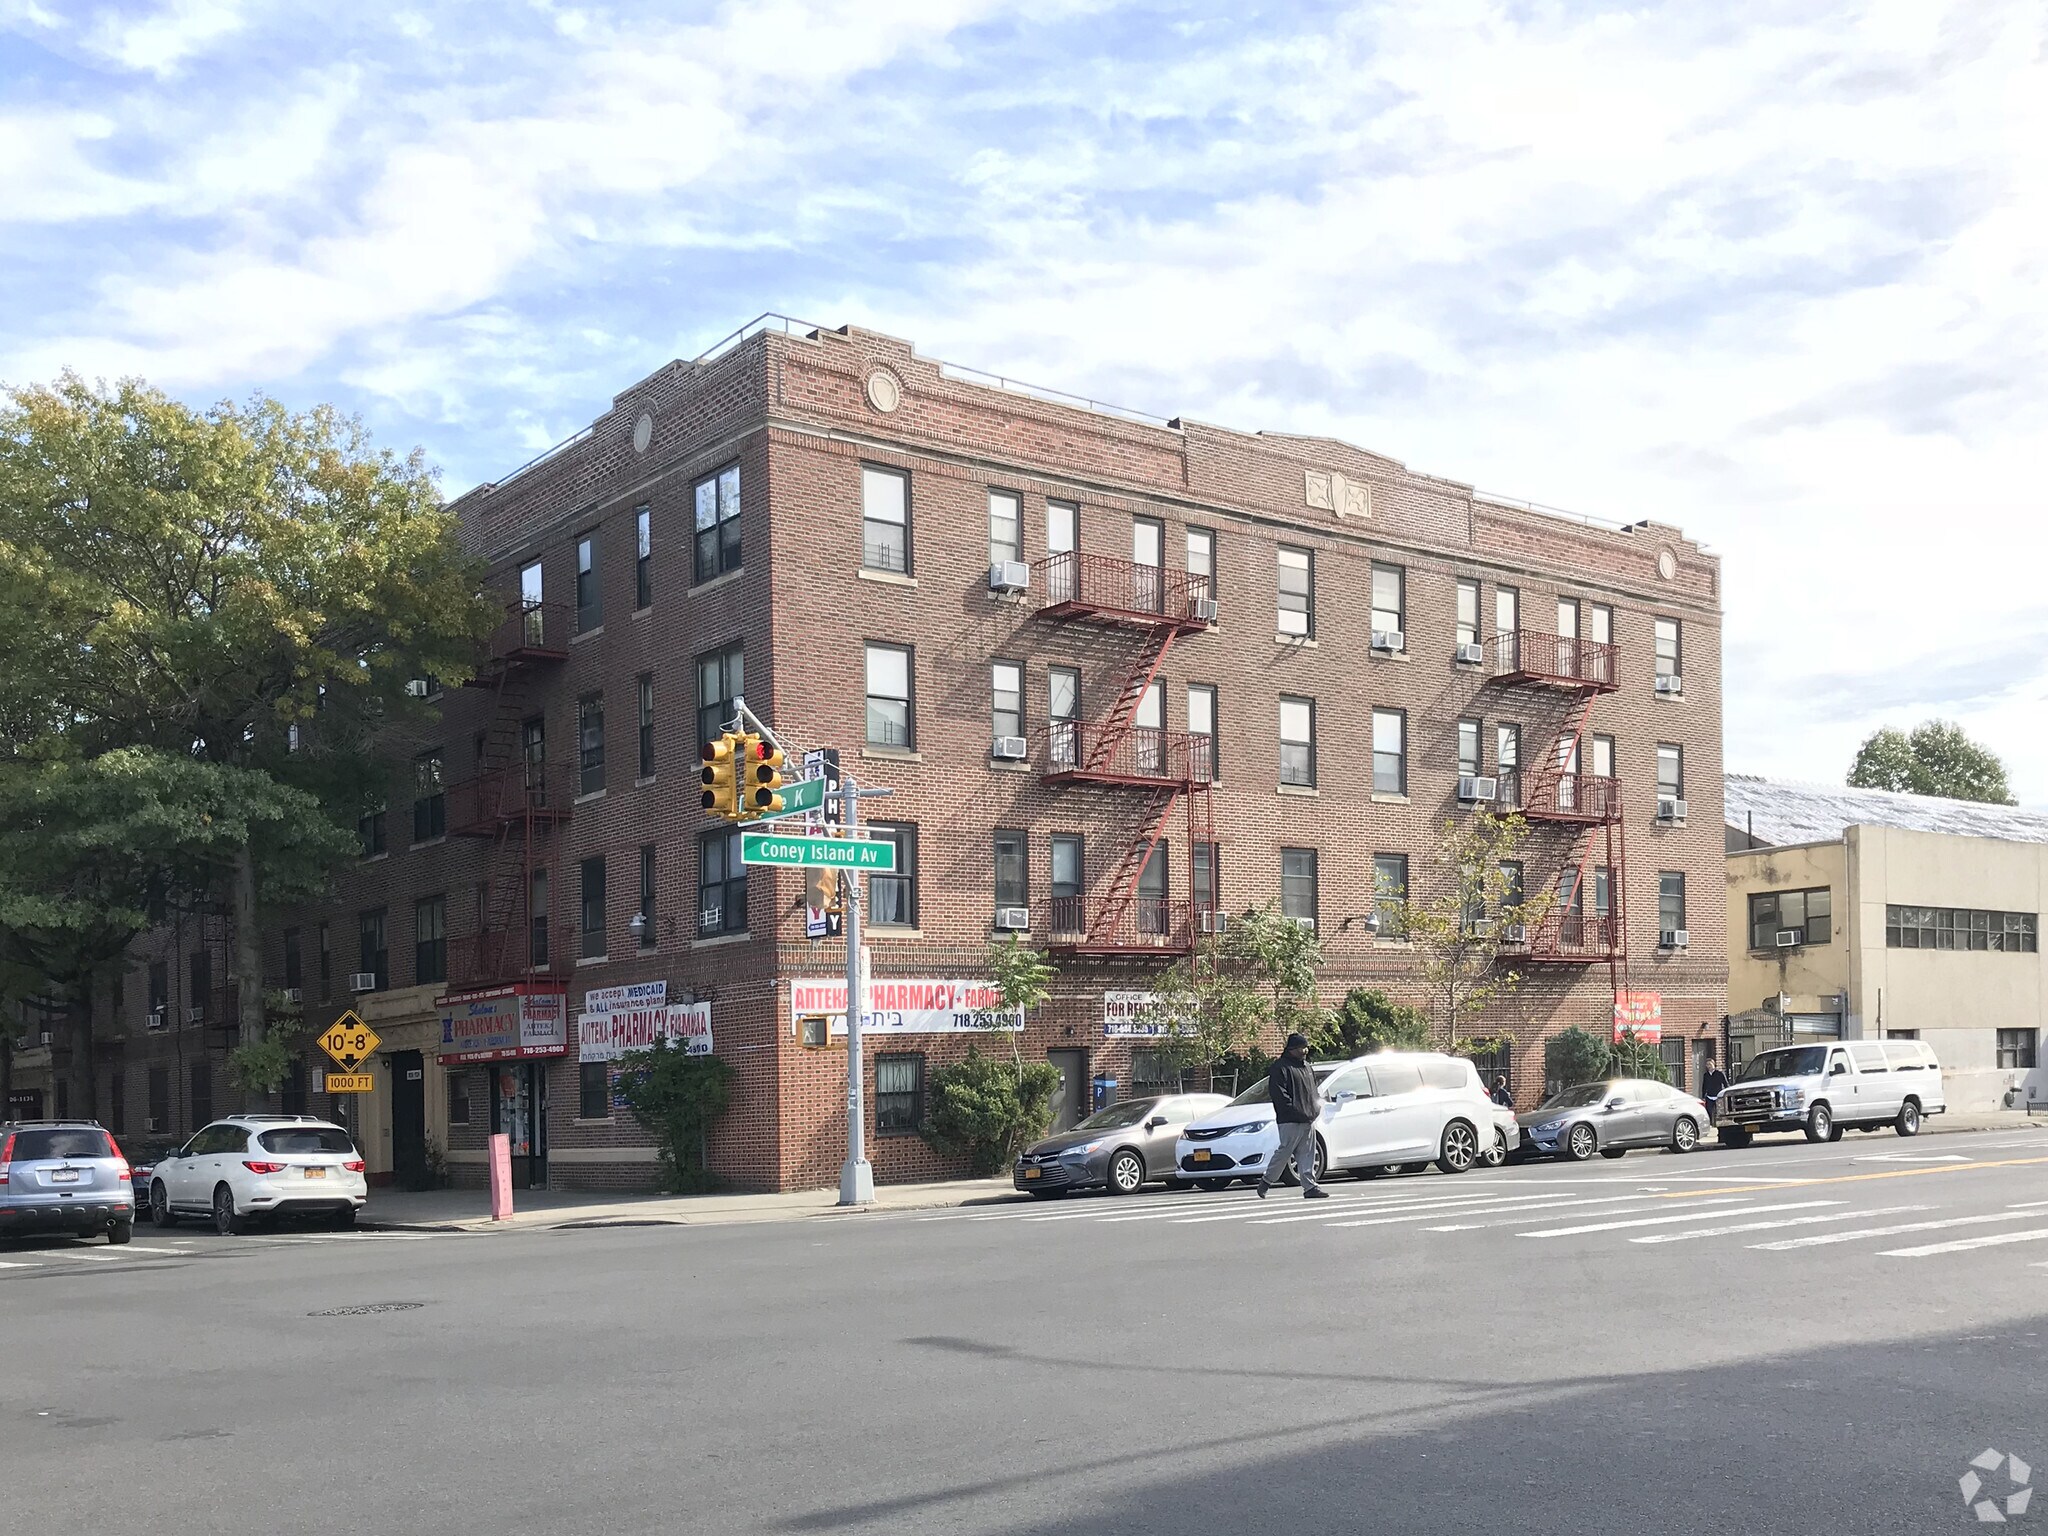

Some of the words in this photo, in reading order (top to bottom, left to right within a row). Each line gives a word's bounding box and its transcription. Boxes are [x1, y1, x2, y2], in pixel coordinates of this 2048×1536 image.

[794, 788, 804, 807] K
[761, 842, 805, 863] Coney
[812, 845, 855, 862] Island
[861, 849, 878, 863] Av
[602, 990, 625, 1000] accept
[627, 983, 664, 998] MEDICAID
[596, 1002, 608, 1013] ALL
[609, 1000, 645, 1010] insurance
[646, 996, 664, 1009] plans
[1107, 1002, 1124, 1017] FOR
[454, 1013, 515, 1037] PHARMACY
[612, 1009, 668, 1048] PHARMACY
[331, 1078, 354, 1088] 1000
[358, 1077, 369, 1088] FT
[1097, 1087, 1103, 1097] P
